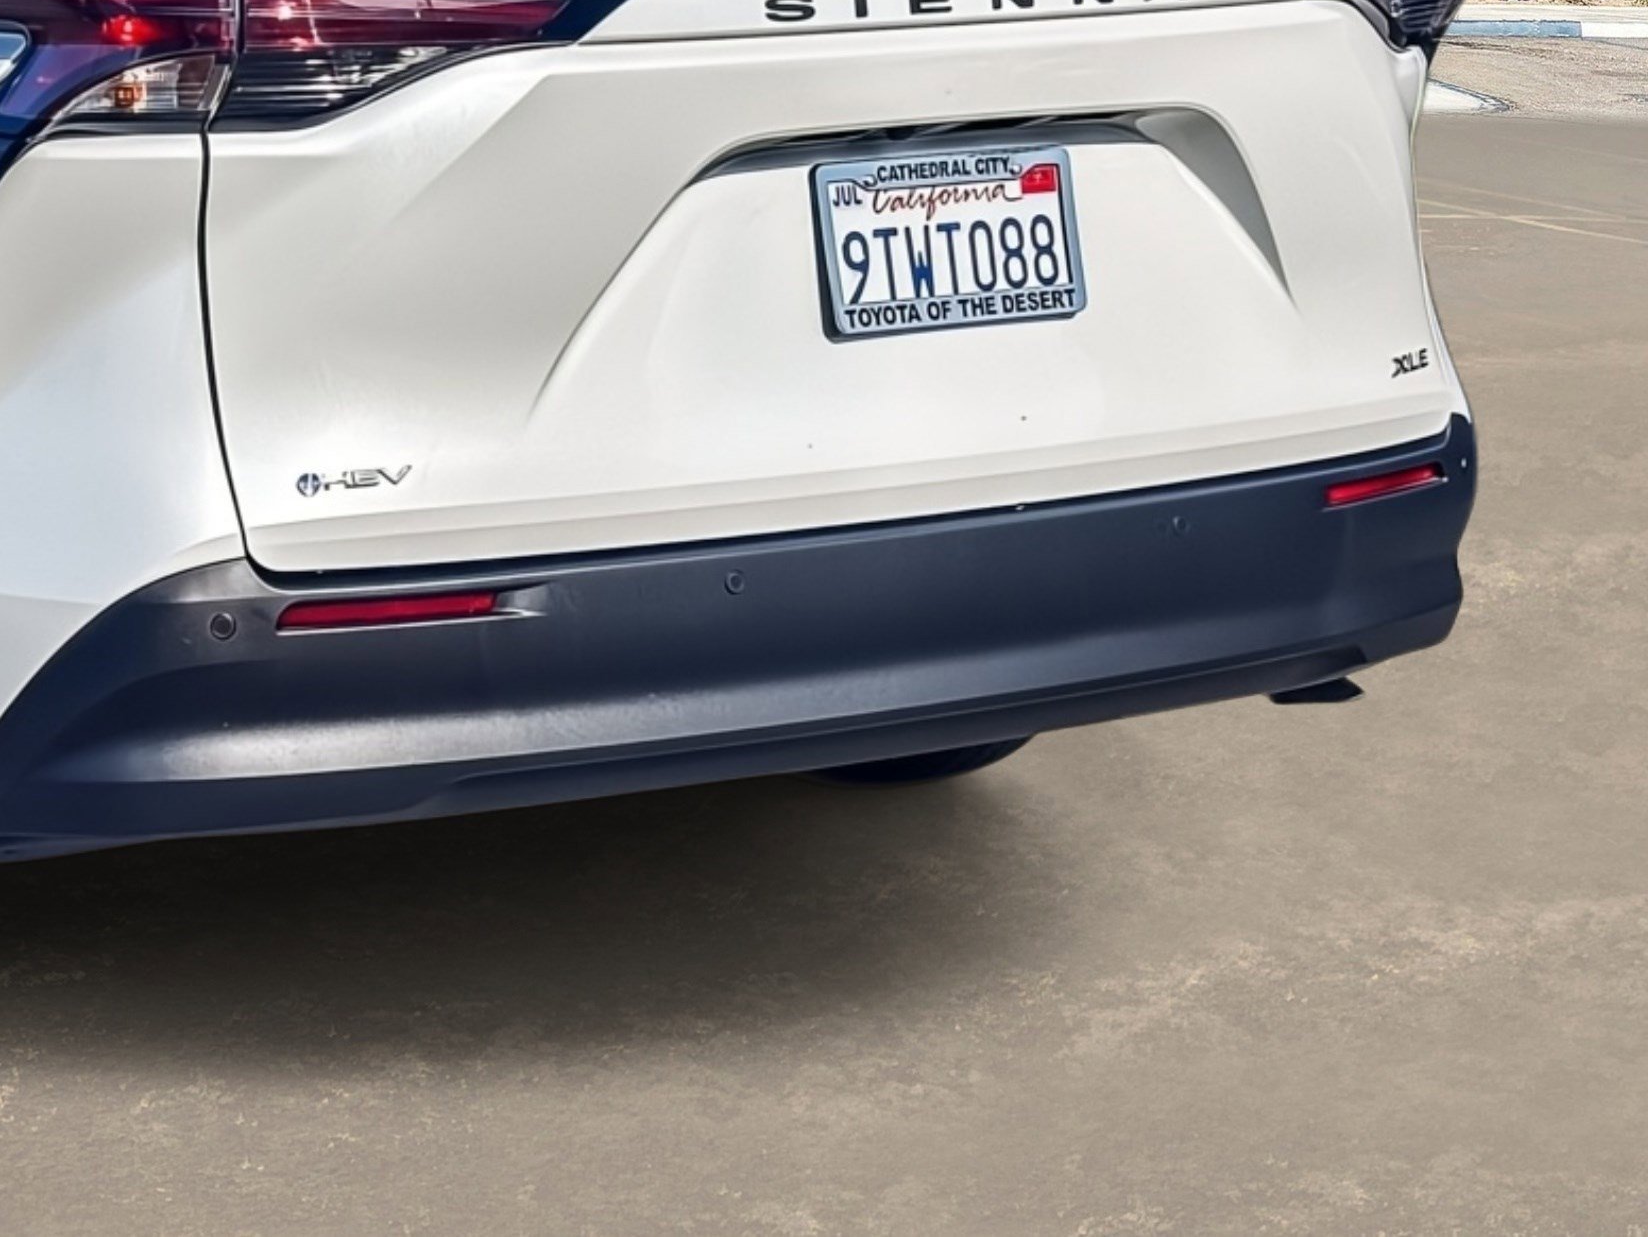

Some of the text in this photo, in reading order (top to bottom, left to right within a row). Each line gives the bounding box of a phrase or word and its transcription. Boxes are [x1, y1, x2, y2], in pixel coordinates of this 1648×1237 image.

[877, 159, 972, 183] CATHEDRAL
[975, 156, 1010, 176] CITY
[832, 185, 863, 207] JUL
[873, 183, 1024, 221] California
[842, 214, 1060, 305] 9TWT088
[844, 288, 1076, 329] TOYOTA OF THE DESERT
[1391, 348, 1429, 378] XLE
